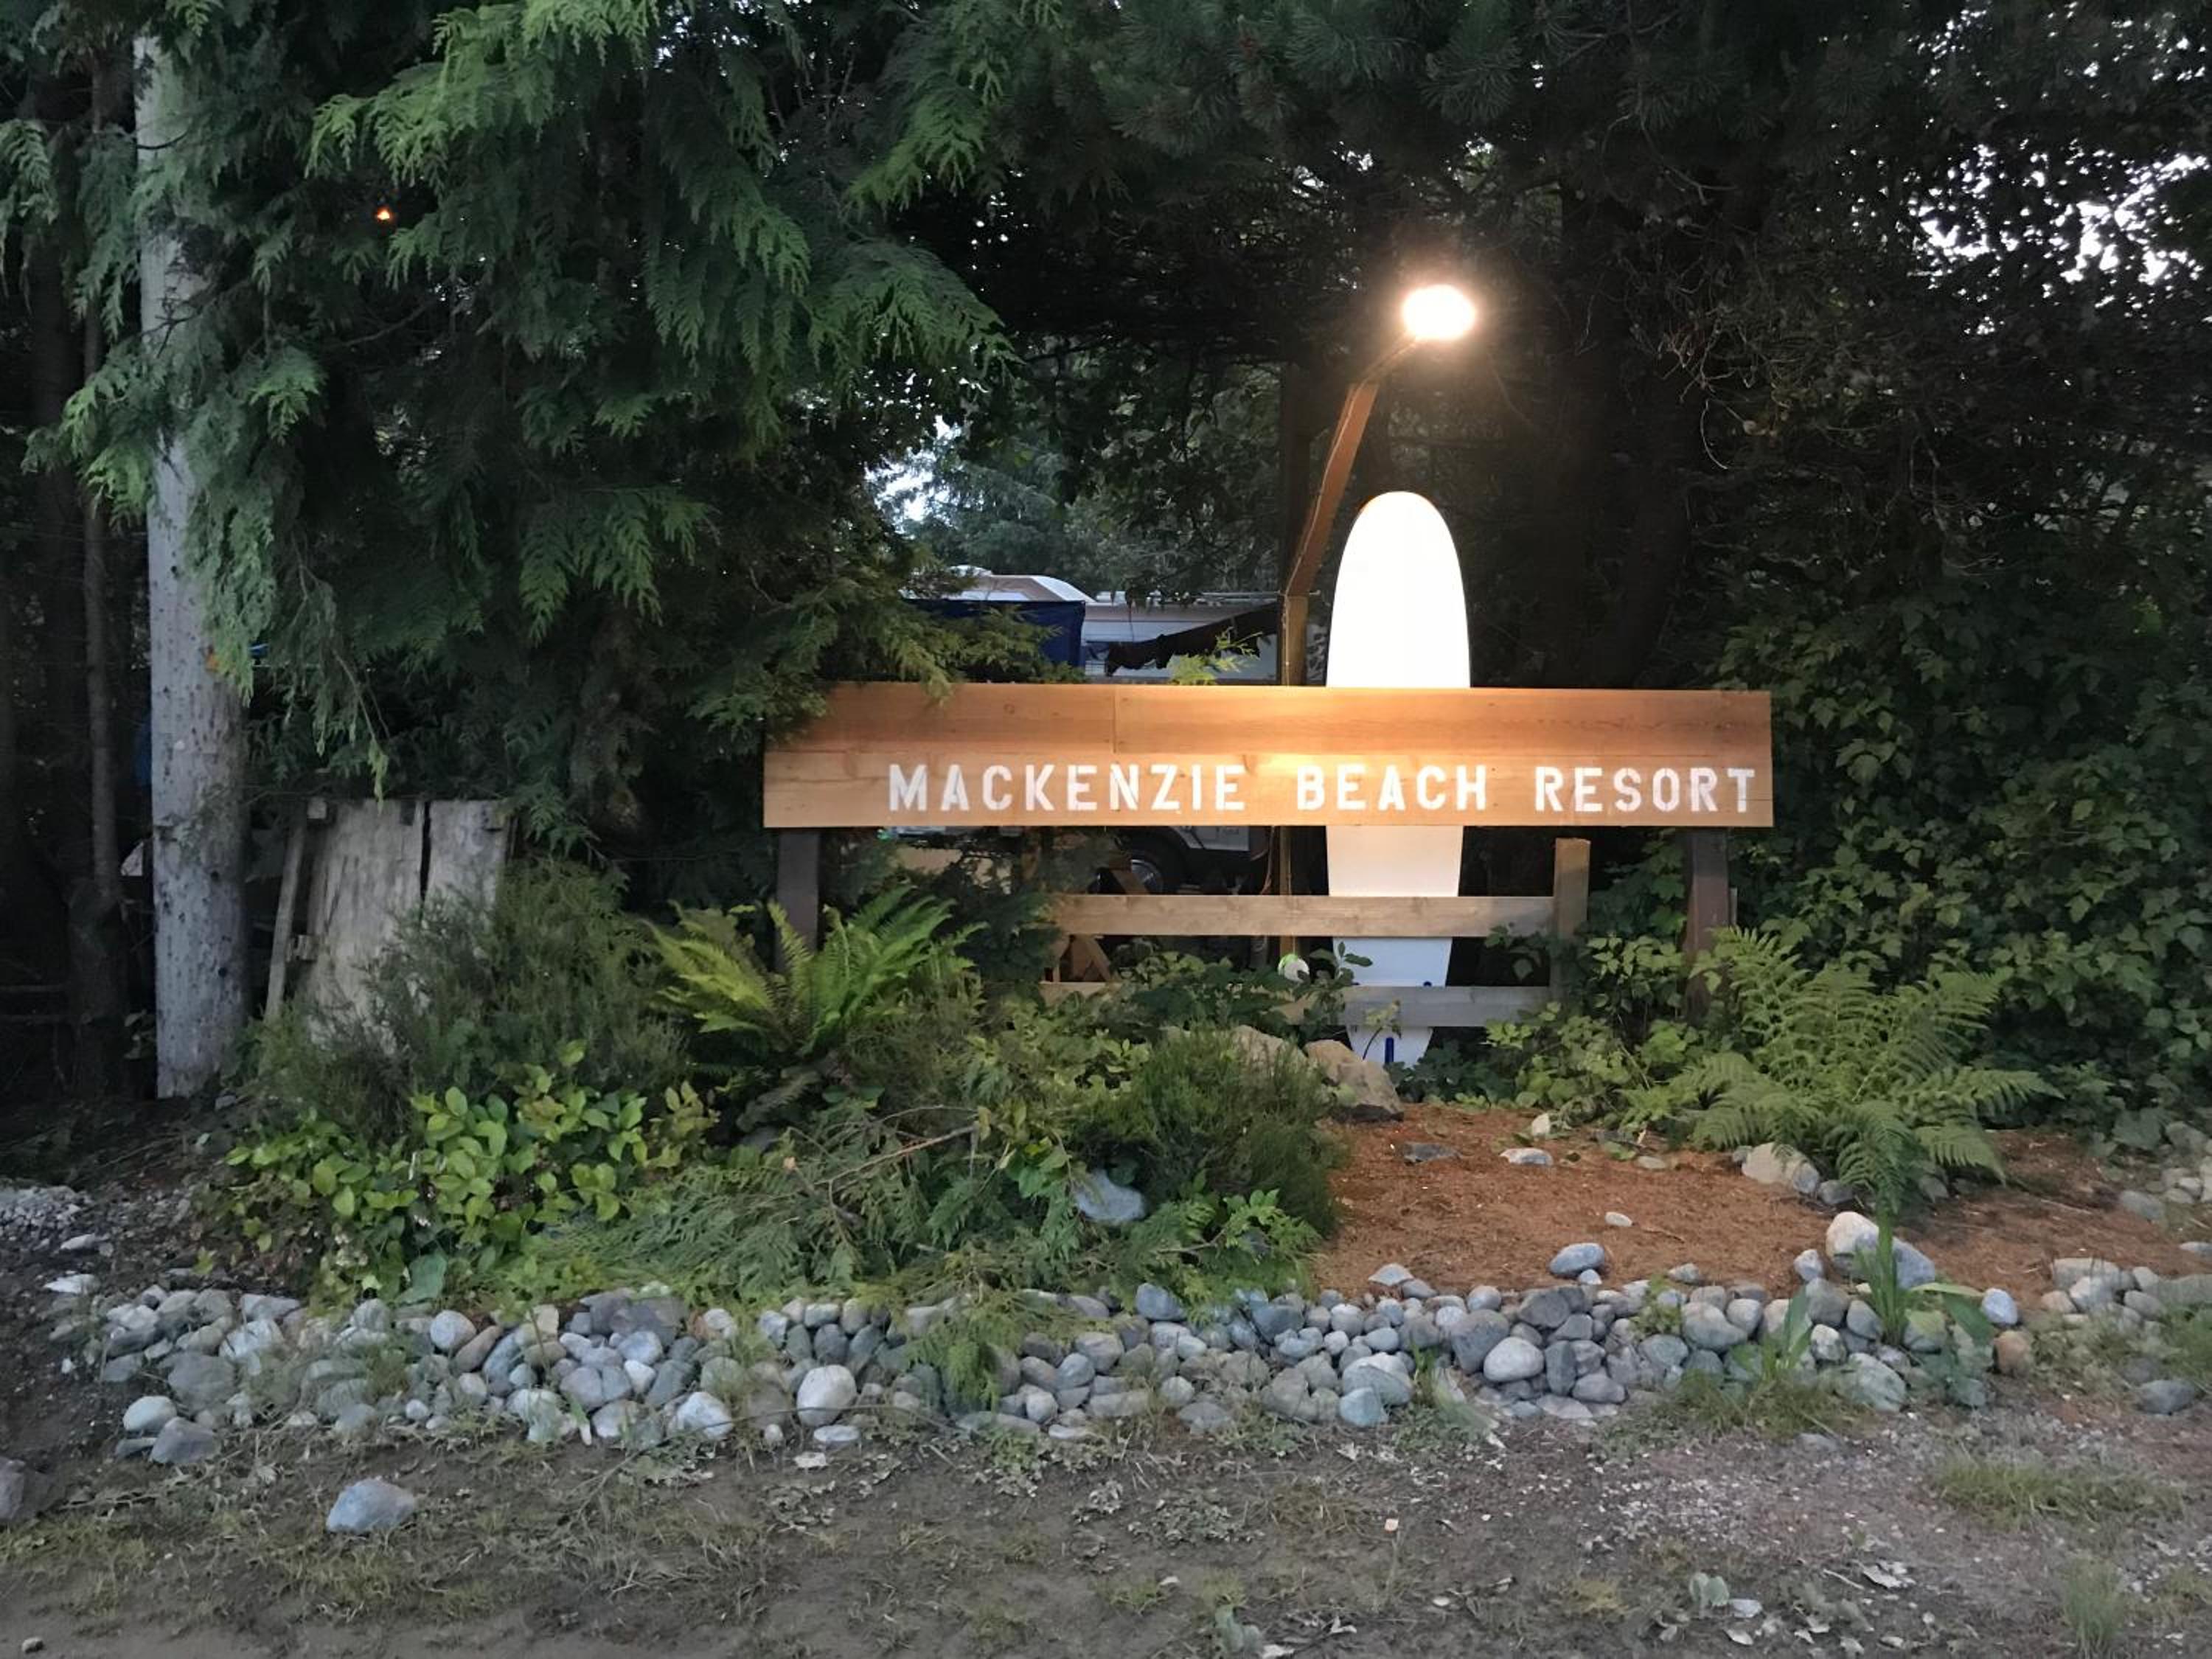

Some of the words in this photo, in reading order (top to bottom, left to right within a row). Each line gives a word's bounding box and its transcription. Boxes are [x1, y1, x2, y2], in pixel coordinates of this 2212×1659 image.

[888, 764, 1245, 811] MACKENZIE
[1296, 765, 1486, 811] BEACH
[1534, 767, 1755, 813] RESORT
